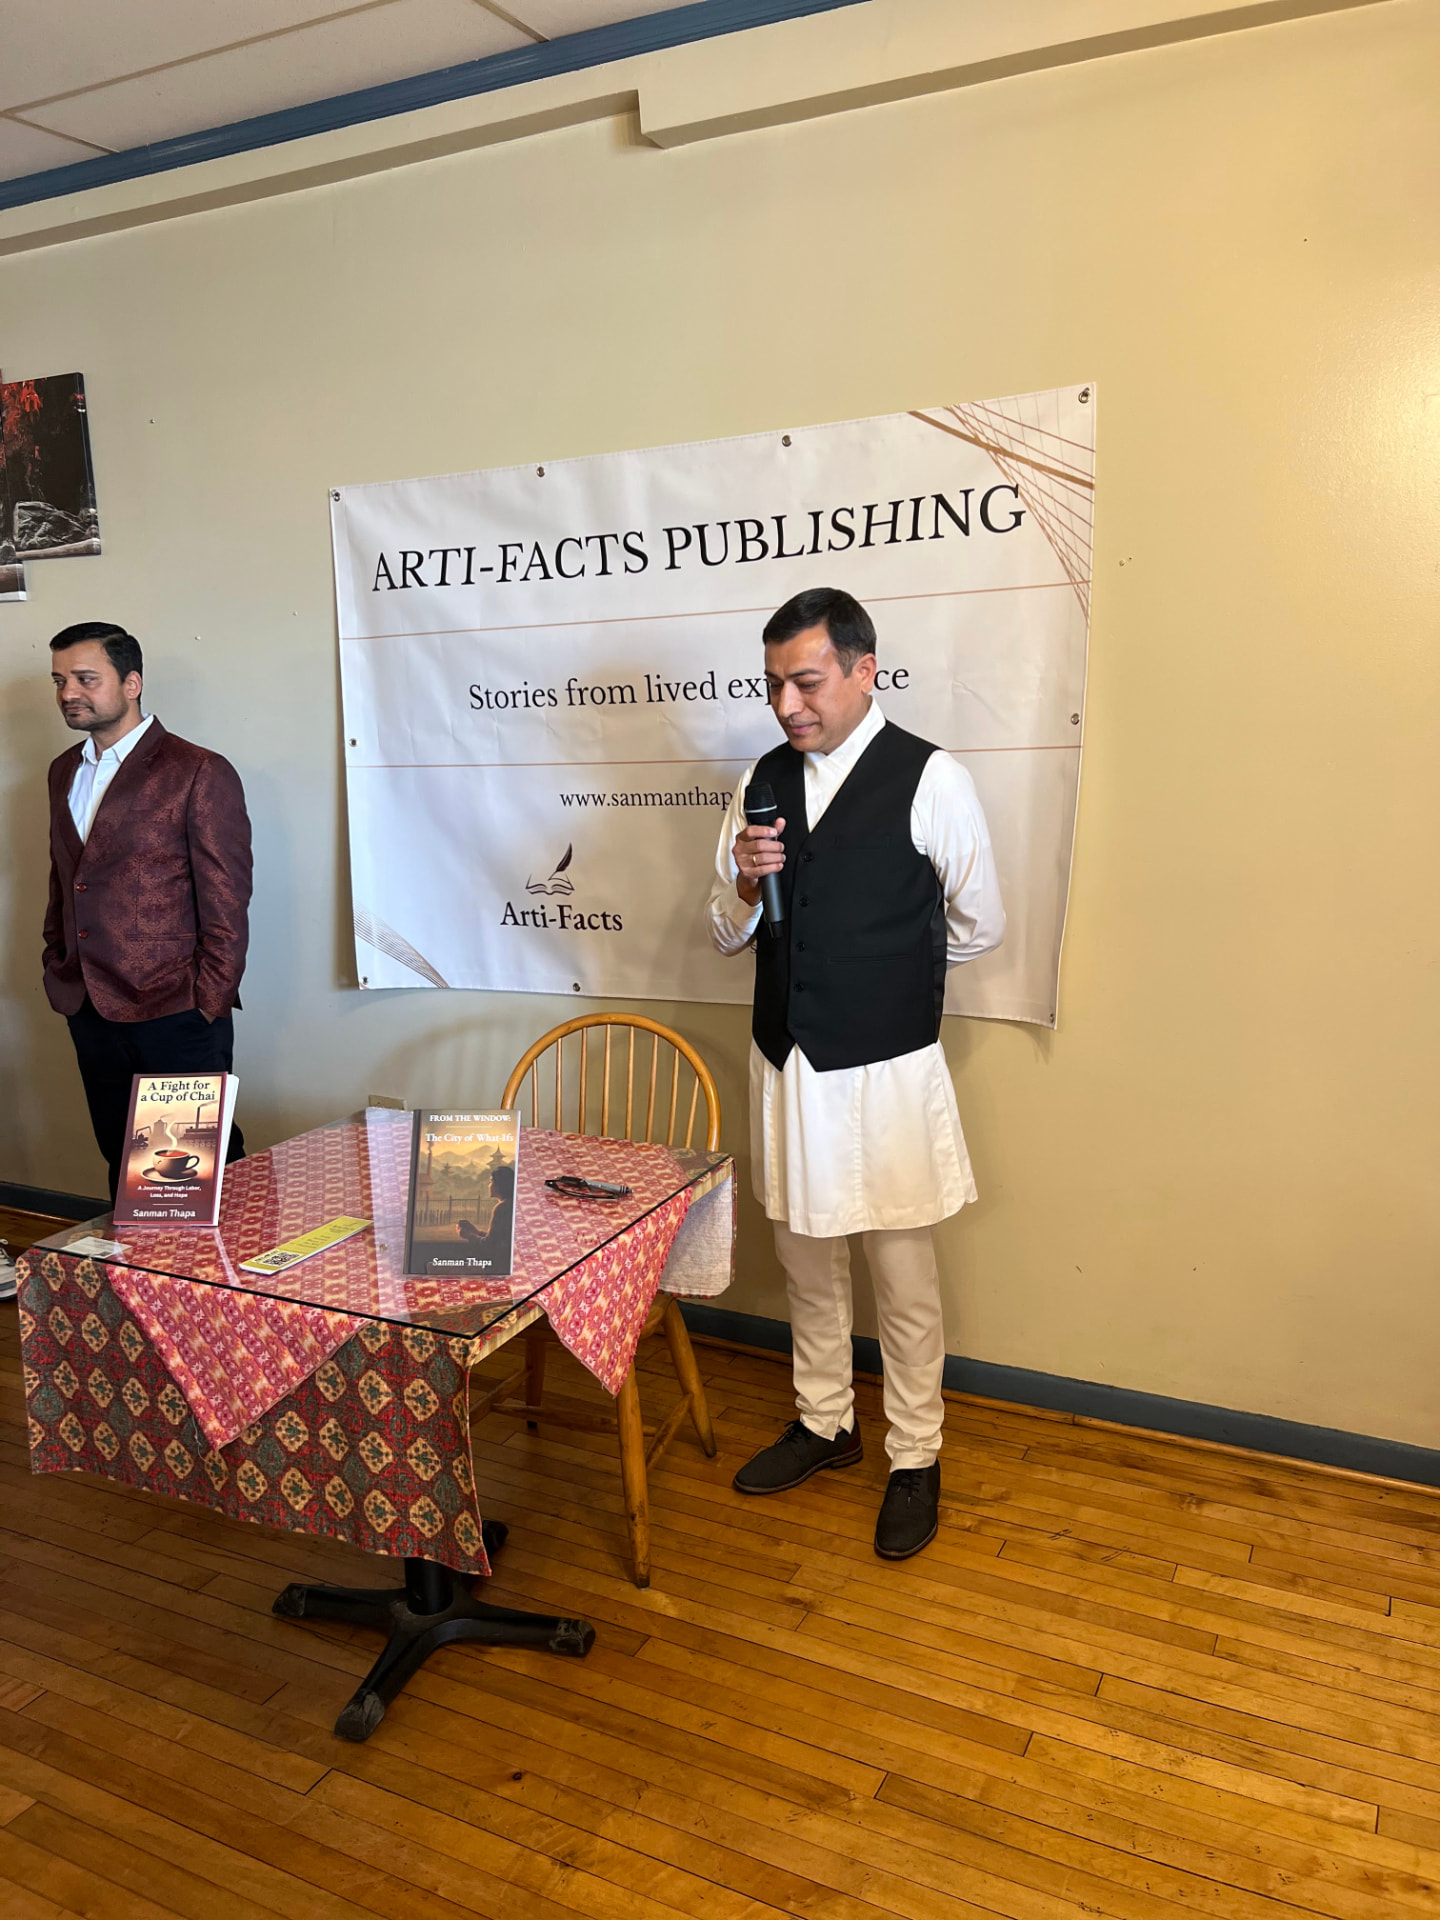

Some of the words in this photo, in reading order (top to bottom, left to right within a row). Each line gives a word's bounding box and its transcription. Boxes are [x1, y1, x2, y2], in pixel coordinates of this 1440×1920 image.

[371, 530, 650, 593] ARTI-FACTS
[661, 483, 1027, 571] PUBLISHING
[468, 681, 559, 711] Stories
[564, 678, 638, 707] from
[643, 670, 719, 704] lived
[559, 786, 734, 812] www.sanmanthap
[500, 901, 624, 932] Arti-Facts
[147, 1081, 158, 1091] A
[160, 1080, 191, 1094] Fight
[193, 1080, 211, 1091] for
[140, 1094, 148, 1102] a
[150, 1092, 174, 1104] Cup
[176, 1091, 188, 1102] of
[189, 1090, 215, 1101] Chai
[429, 1114, 453, 1122] FROM
[455, 1114, 472, 1122] THE
[425, 1133, 442, 1142] The
[444, 1133, 462, 1145] City
[464, 1132, 475, 1142] of
[476, 1133, 514, 1142] What-Ifs
[133, 1209, 168, 1218] Sanman
[169, 1209, 196, 1219] Thapa
[432, 1257, 465, 1267] Sanman
[466, 1257, 493, 1269] Thapa
